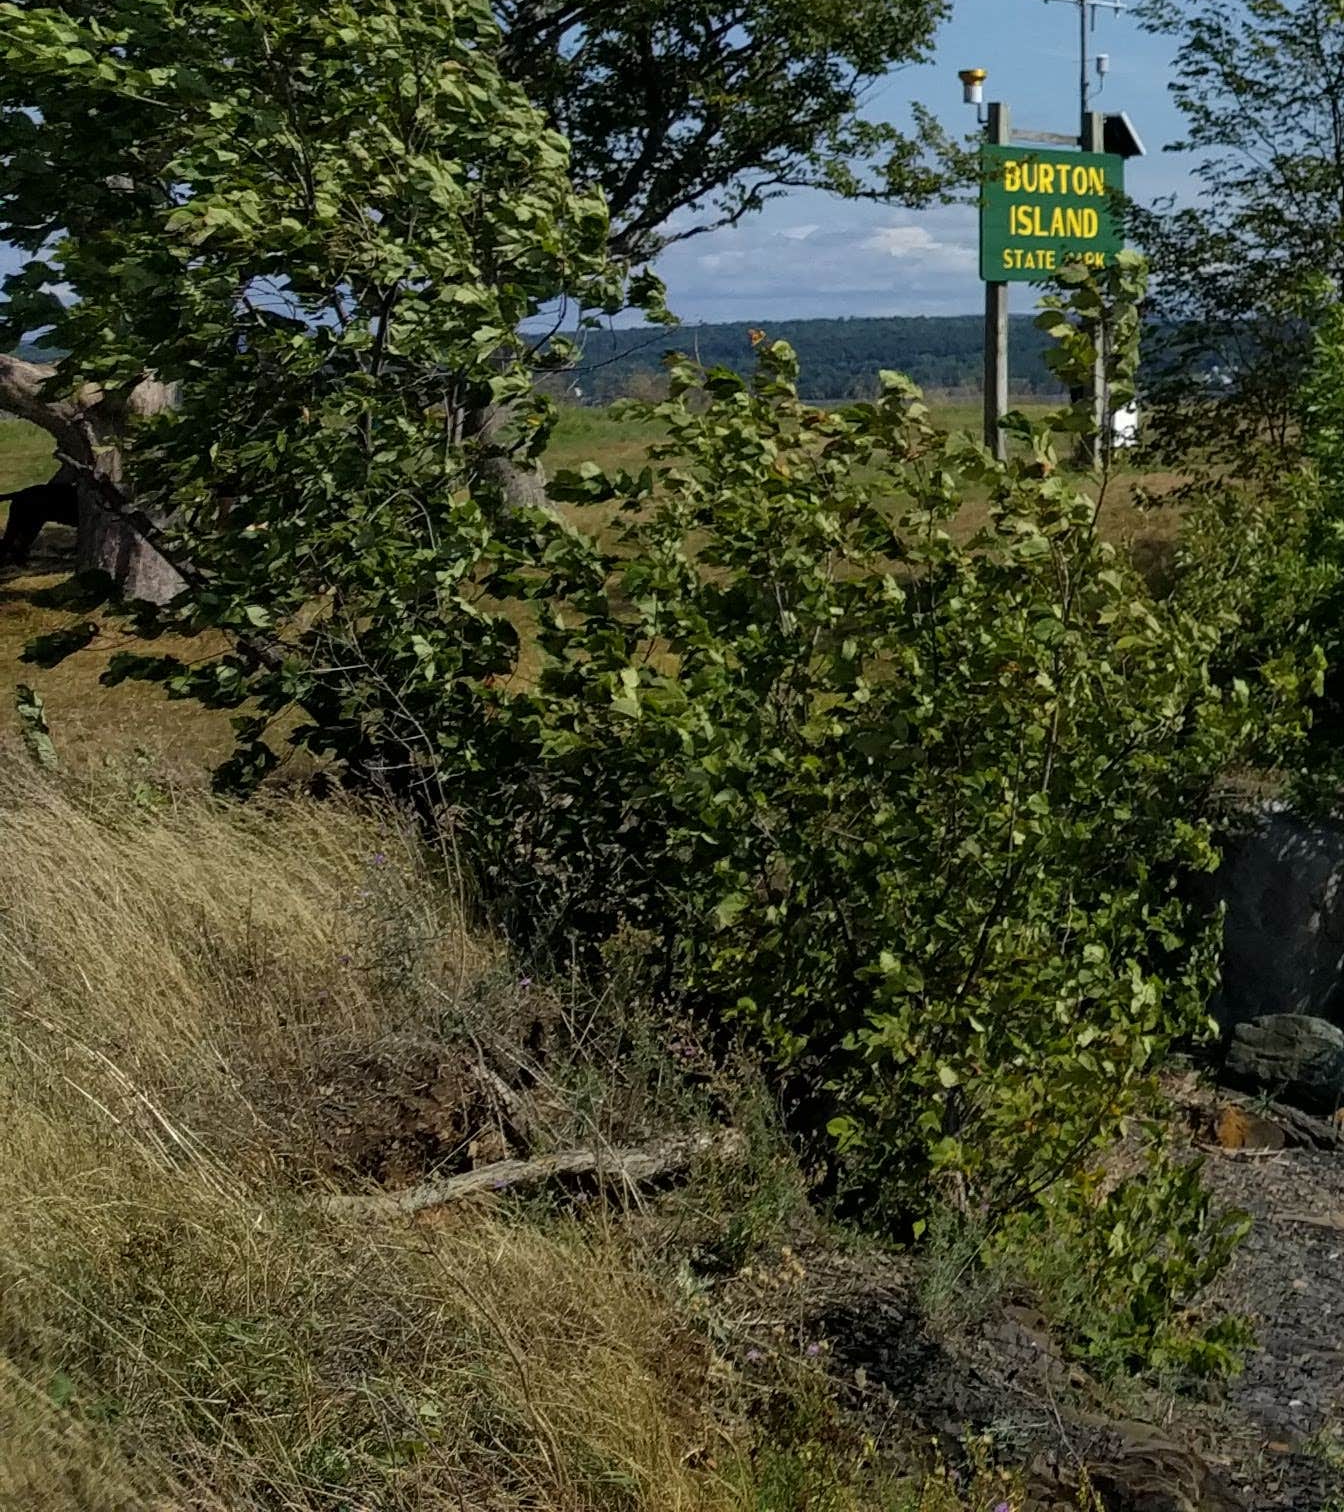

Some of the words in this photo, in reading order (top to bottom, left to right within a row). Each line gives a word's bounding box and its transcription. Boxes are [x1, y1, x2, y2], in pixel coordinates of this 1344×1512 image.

[1004, 160, 1104, 196] BURTON
[1010, 205, 1098, 238] ISLAND
[1003, 249, 1056, 269] STATE
